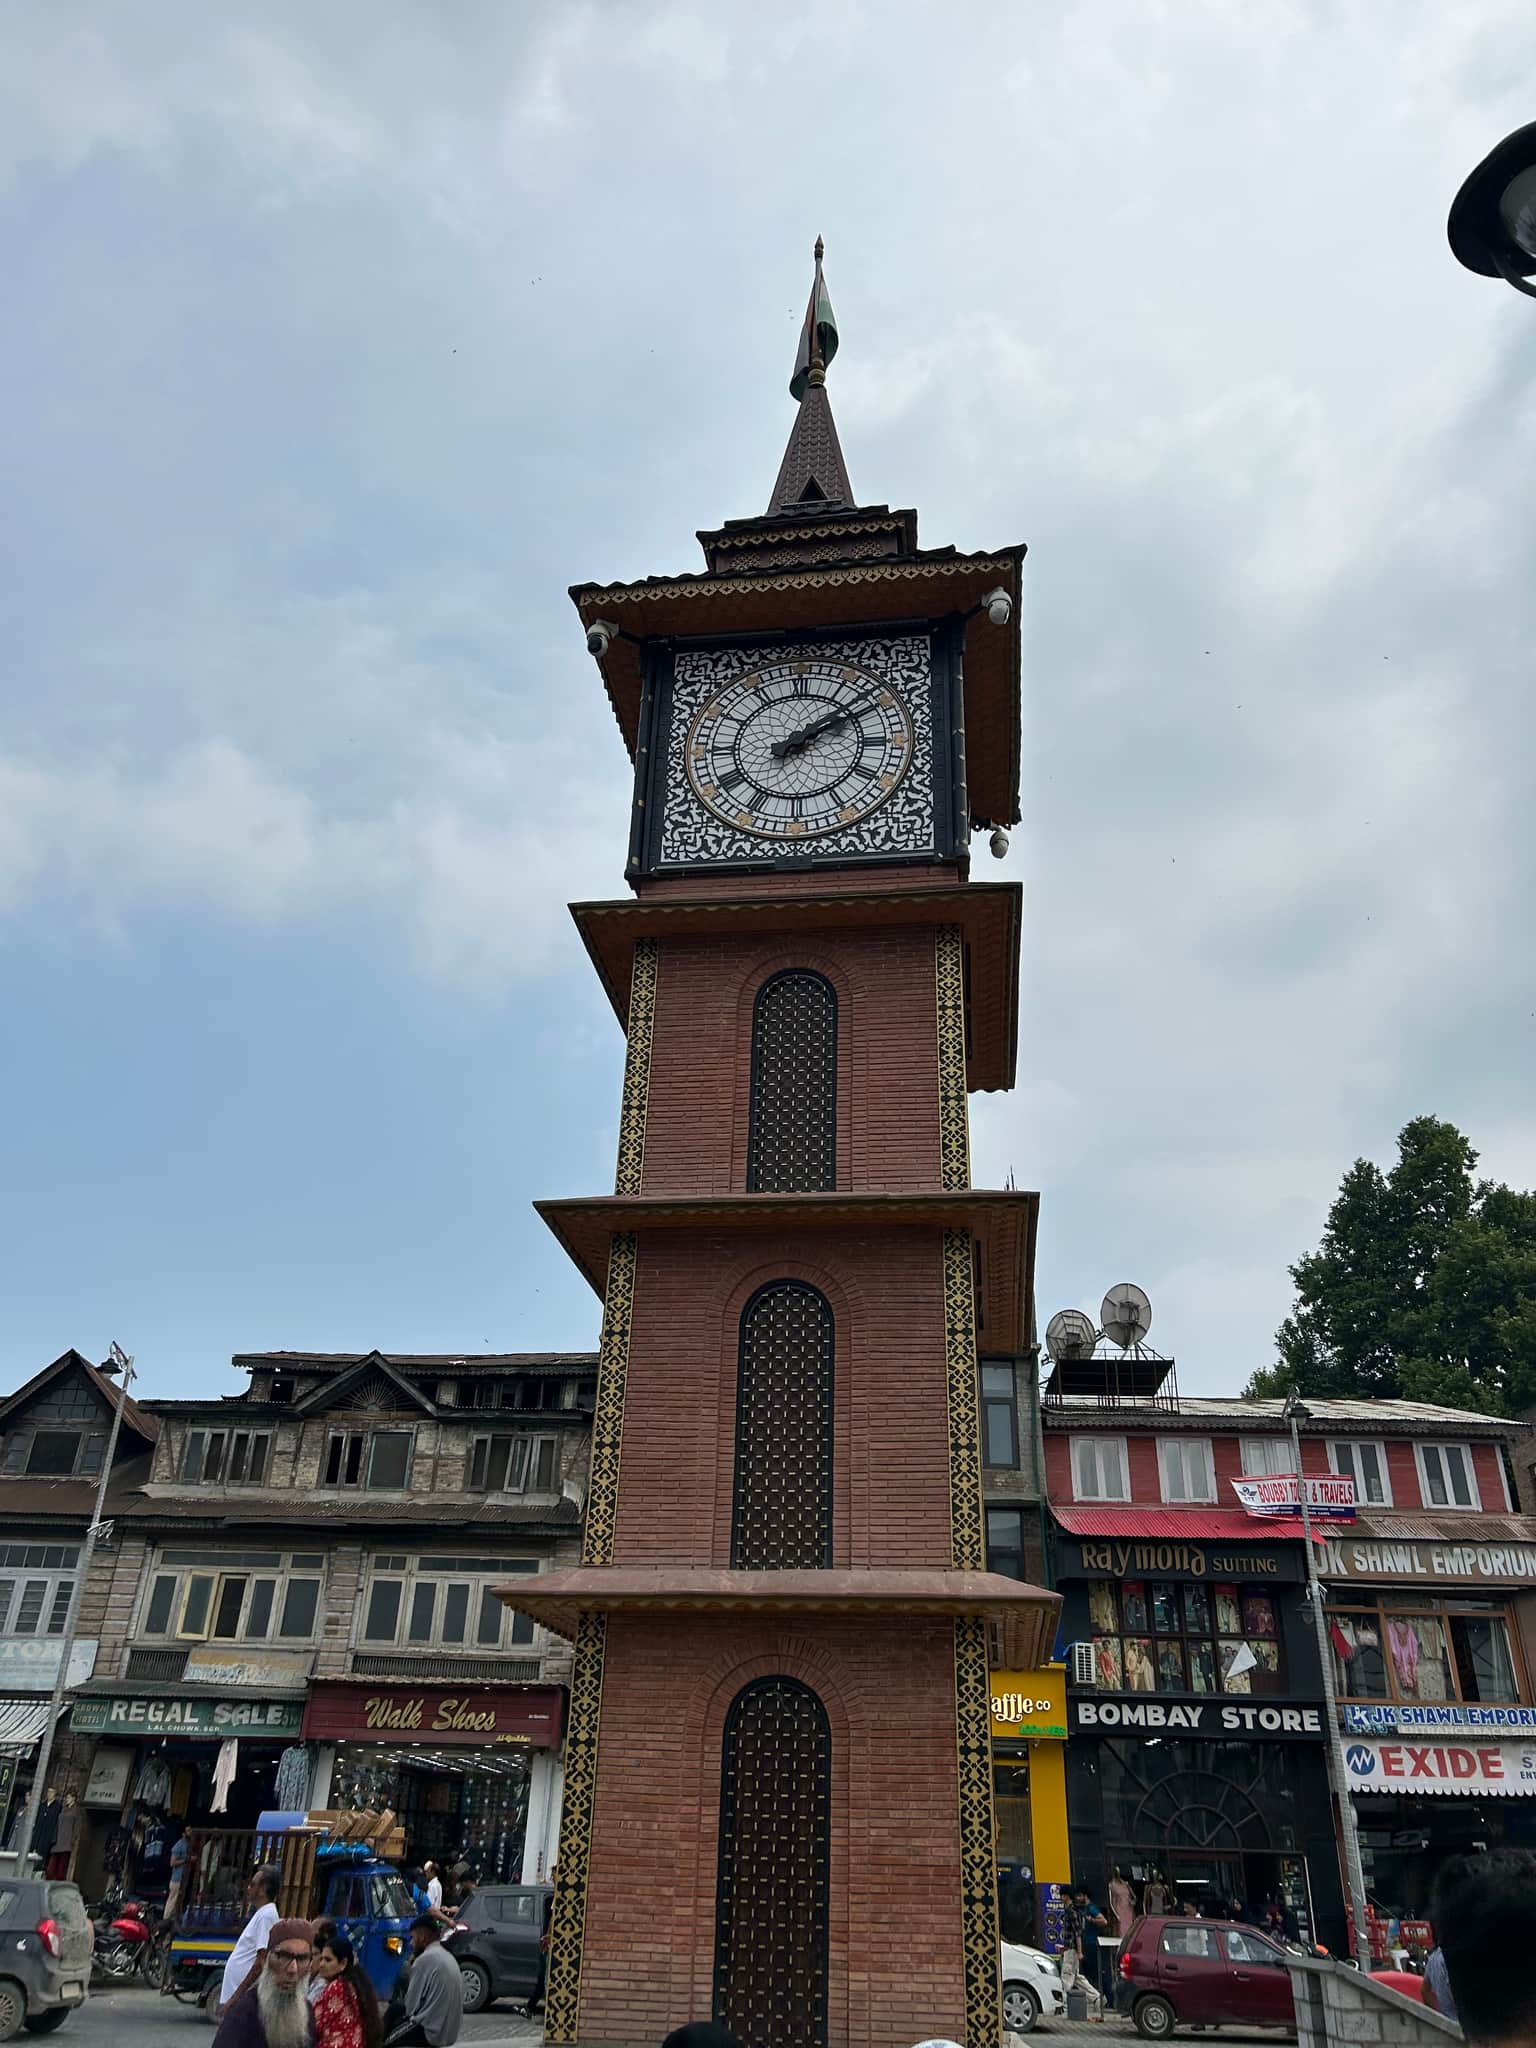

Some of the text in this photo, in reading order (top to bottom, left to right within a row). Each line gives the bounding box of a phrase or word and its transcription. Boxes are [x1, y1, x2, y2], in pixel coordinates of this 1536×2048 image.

[1312, 1482, 1318, 1503] &
[1319, 1483, 1353, 1504] TRAVELS
[1080, 1542, 1278, 1577] Raymond SUITING
[1353, 1544, 1427, 1574] SHAWL
[110, 1700, 200, 1724] REGAL
[213, 1703, 284, 1727] SALE
[365, 1697, 497, 1732] Walk Shoes
[990, 1692, 1034, 1723] affle
[1078, 1703, 1321, 1732] BOMBAY STORE
[1373, 1706, 1396, 1724] JK
[1402, 1707, 1463, 1725] SHAWL
[1379, 1746, 1504, 1779] EXIDE
